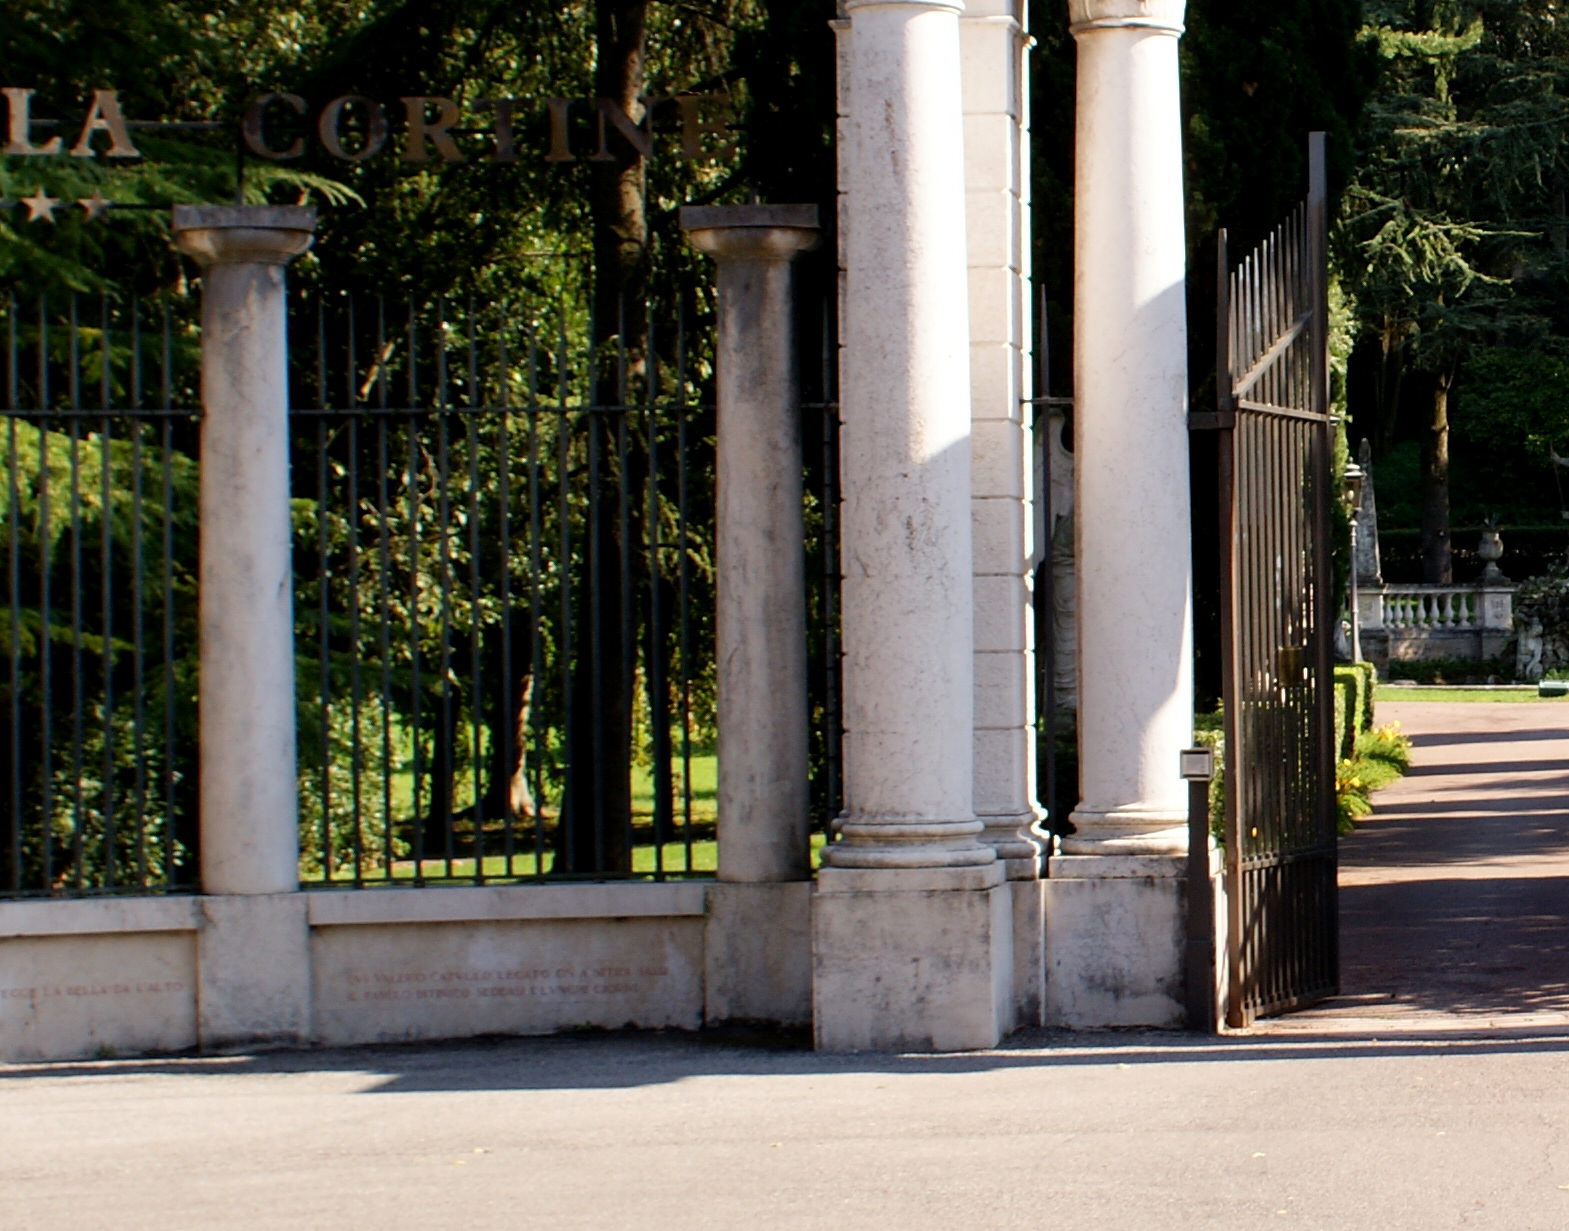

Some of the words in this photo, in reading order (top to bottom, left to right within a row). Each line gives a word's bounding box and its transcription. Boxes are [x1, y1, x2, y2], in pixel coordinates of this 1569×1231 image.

[241, 92, 736, 163] CORTINE
[497, 969, 550, 980] LEGATO
[67, 984, 108, 997] BELLA
